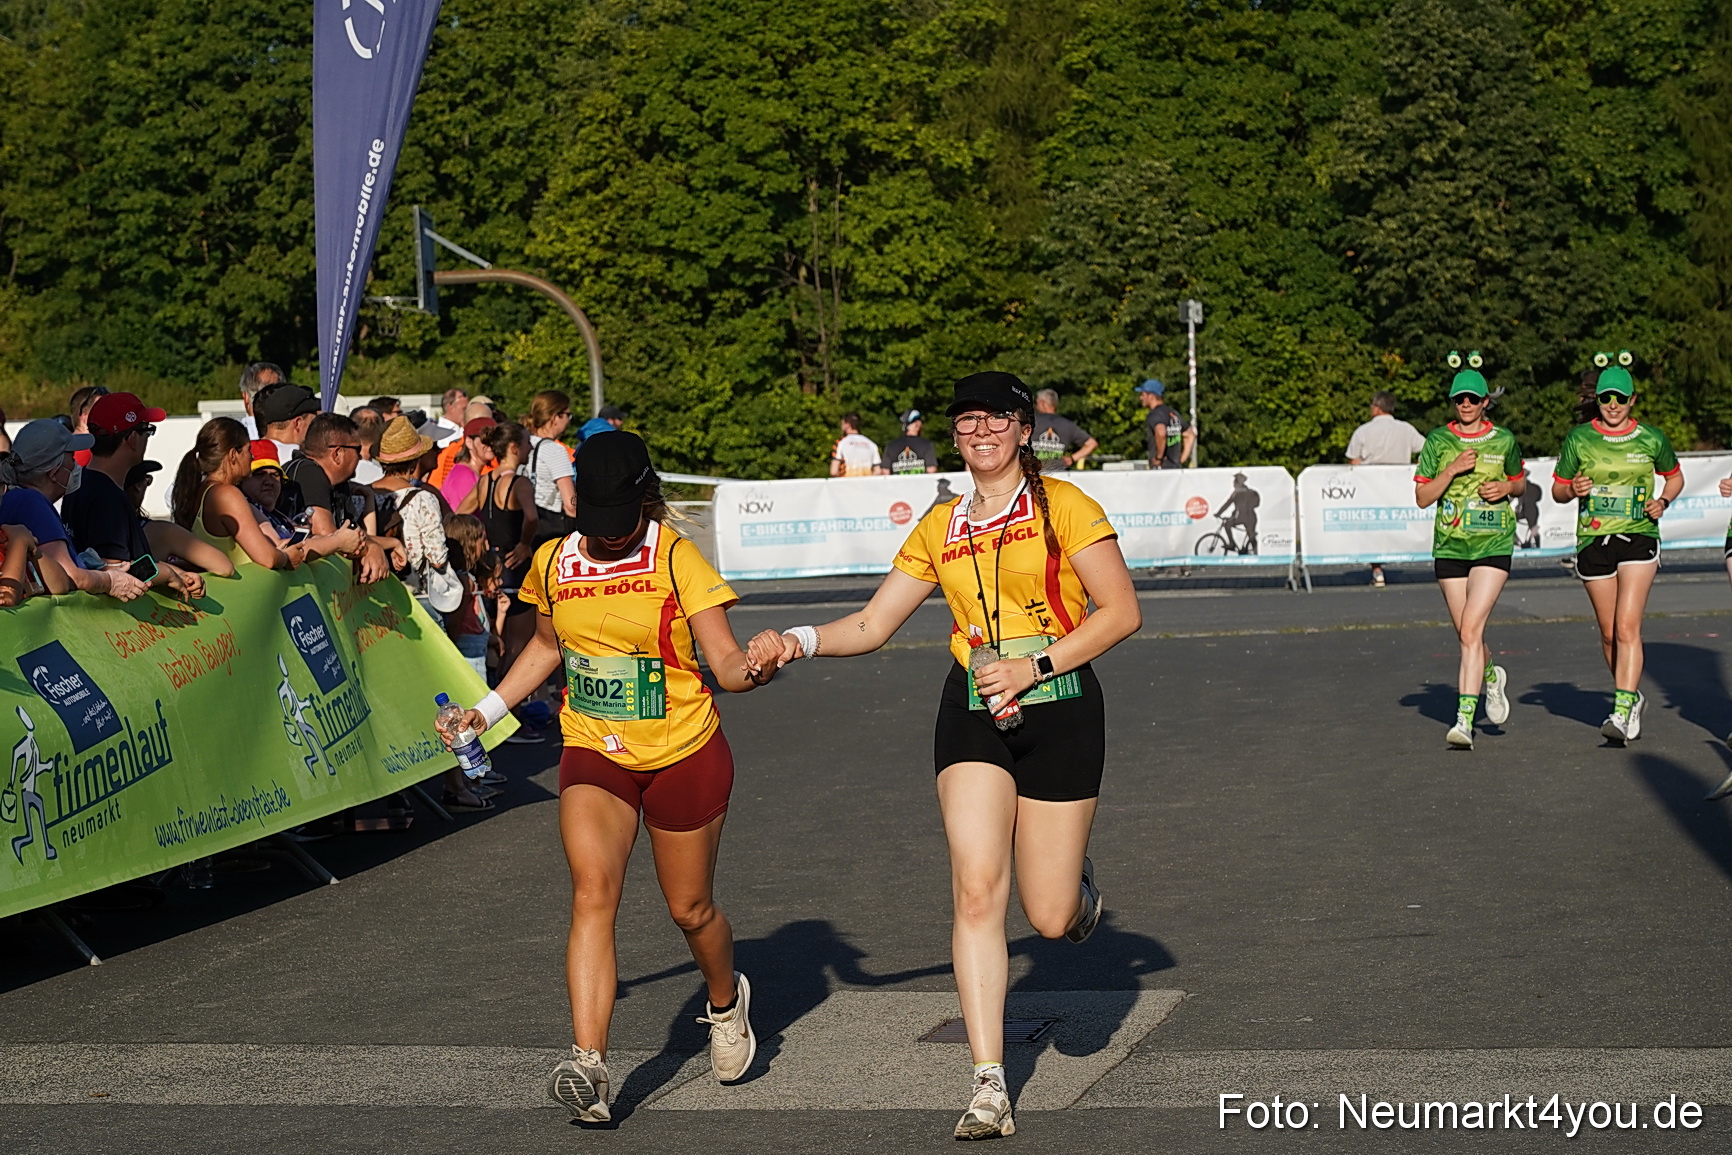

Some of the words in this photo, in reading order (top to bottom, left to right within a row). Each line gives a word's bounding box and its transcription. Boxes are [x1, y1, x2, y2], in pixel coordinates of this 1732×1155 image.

[1321, 487, 1356, 499] NOW
[1602, 497, 1617, 508] 37
[738, 501, 774, 514] NOW
[1325, 508, 1376, 521] E-BIKES
[1379, 508, 1388, 519] &
[1479, 510, 1494, 521] 48
[742, 523, 794, 536] E-BIKES
[797, 522, 808, 534] &
[941, 541, 986, 565] MAX
[556, 586, 597, 602] MAX
[604, 579, 657, 596] BÖGL
[298, 624, 326, 648] Fischer
[44, 673, 84, 700] Fischer
[63, 688, 91, 707] AUTOMOBILE
[574, 673, 624, 700] 1602
[625, 682, 635, 711] 2022
[602, 700, 626, 708] Marina
[53, 698, 173, 819] firmenlauf
[62, 798, 121, 848] neumarkt
[154, 779, 291, 848] www.firmenlauf-oberpfalz.de
